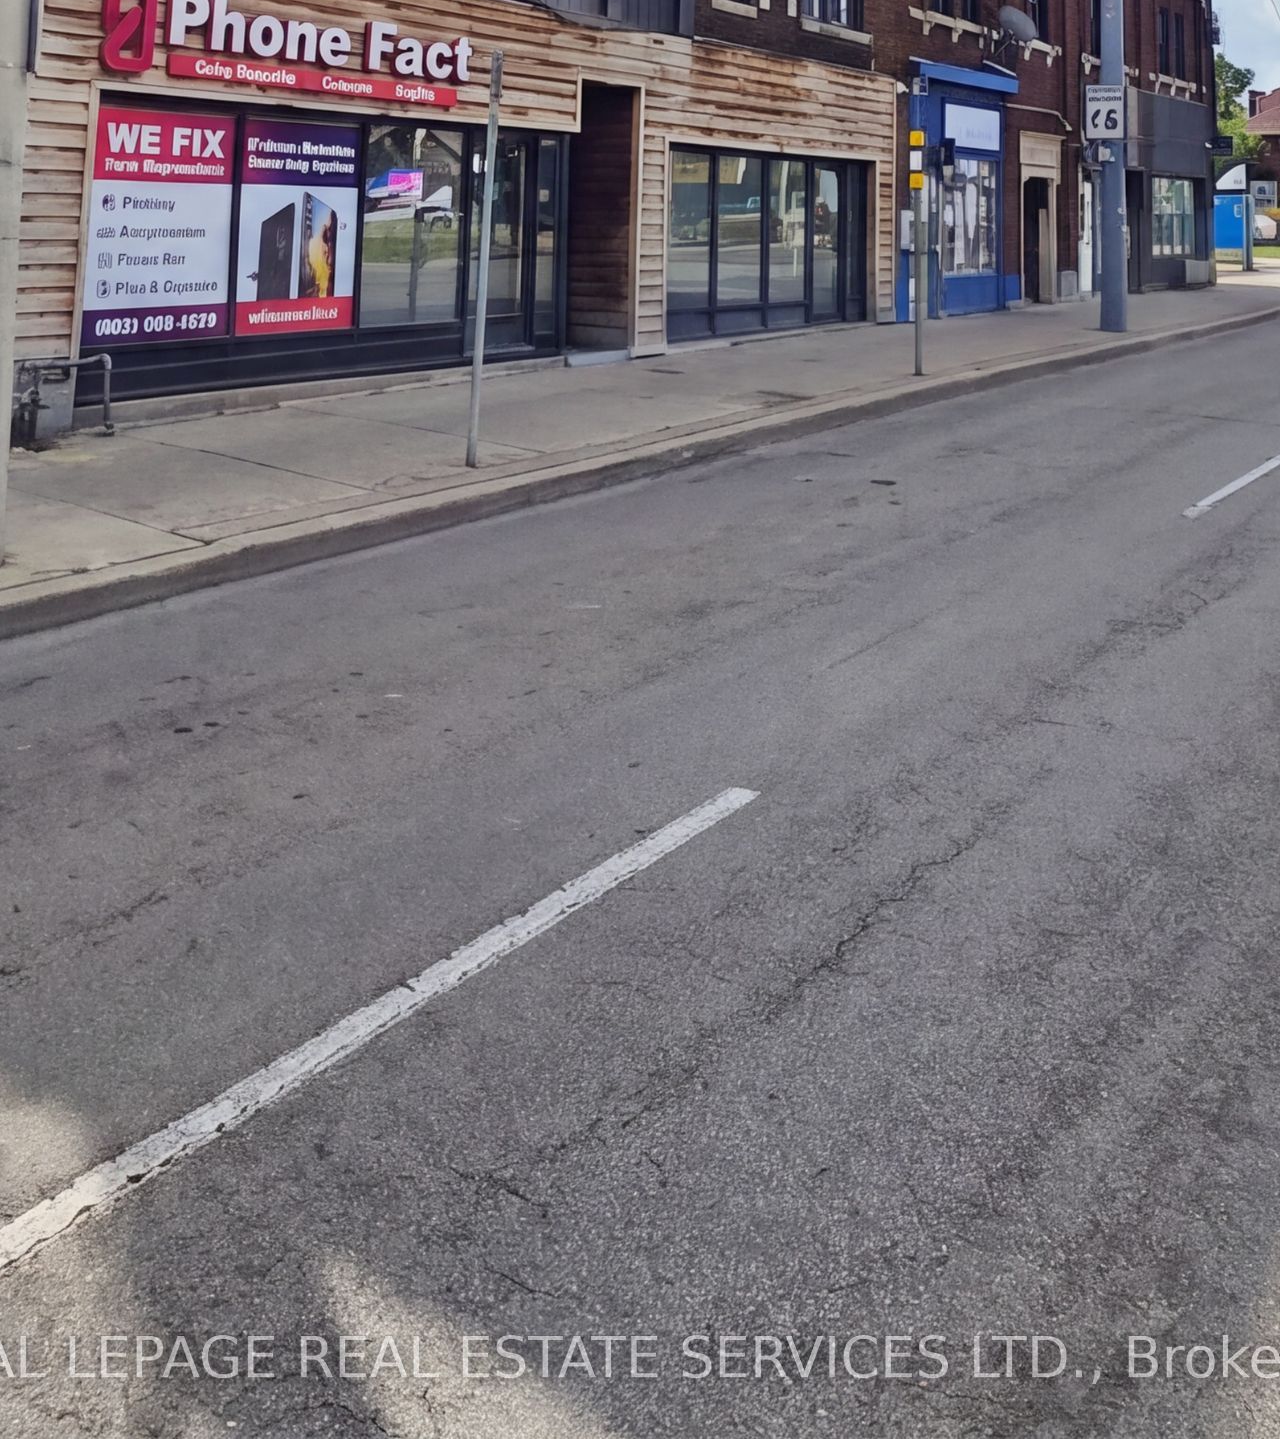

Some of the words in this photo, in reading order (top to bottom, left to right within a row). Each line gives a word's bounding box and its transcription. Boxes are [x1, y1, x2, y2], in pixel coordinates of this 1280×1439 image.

[366, 21, 473, 81] Fact
[107, 122, 161, 155] WE
[172, 127, 226, 159] FIX
